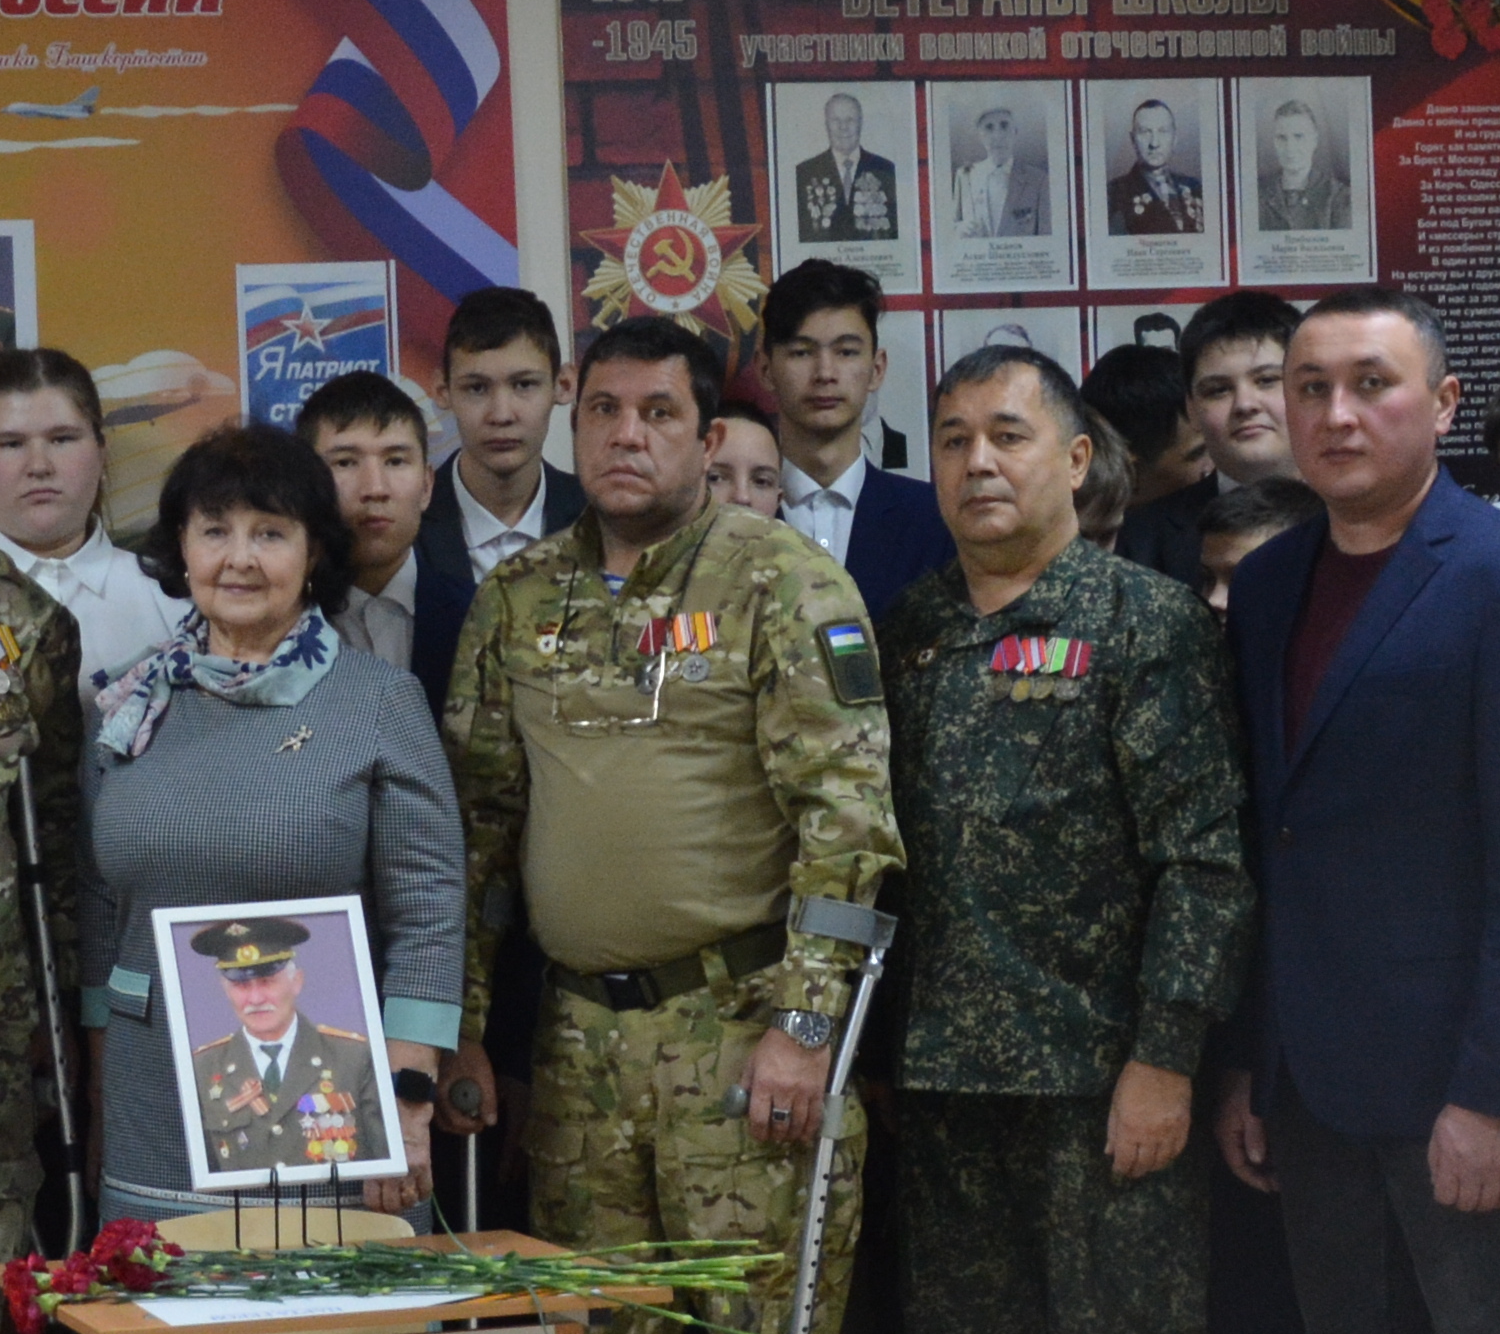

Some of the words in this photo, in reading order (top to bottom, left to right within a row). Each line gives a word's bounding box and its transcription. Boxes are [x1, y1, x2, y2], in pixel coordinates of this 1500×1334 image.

[592, 19, 697, 61] -1945
[740, 32, 903, 68] участники
[920, 28, 1047, 60] великой
[1062, 24, 1286, 59] отечественной
[1301, 24, 1395, 57] войны
[47, 42, 208, 73] Башкортостан
[1427, 104, 1458, 115] Давно
[1393, 118, 1424, 128] Давно
[1436, 118, 1469, 126] войны
[1454, 130, 1462, 138] И
[1400, 156, 1411, 164] За
[1433, 168, 1440, 176] И
[1457, 168, 1497, 177] блокаду
[1420, 181, 1431, 189] За
[1421, 194, 1433, 202] За
[1456, 194, 1495, 202] осколки
[1429, 207, 1436, 215] А
[1418, 219, 1437, 228] Бои
[1440, 220, 1459, 228] под
[1462, 218, 1492, 228] Бугом
[1418, 232, 1425, 240] И
[1429, 232, 1484, 241] «мессеры»
[1419, 245, 1425, 253] И
[1443, 244, 1492, 252] ложбинки
[626, 214, 709, 303] ОТЕЧЕСТВЕННАЯ
[692, 246, 720, 301] ВОЙНА
[1432, 258, 1439, 266] В
[1442, 257, 1466, 266] один
[1392, 271, 1405, 280] На
[1408, 271, 1447, 281] встречу
[1404, 283, 1417, 292] Но
[1428, 283, 1468, 292] каждым
[1472, 282, 1500, 290] годом
[1464, 308, 1500, 317] сумели
[1444, 320, 1457, 328] Не
[255, 347, 285, 380] Я
